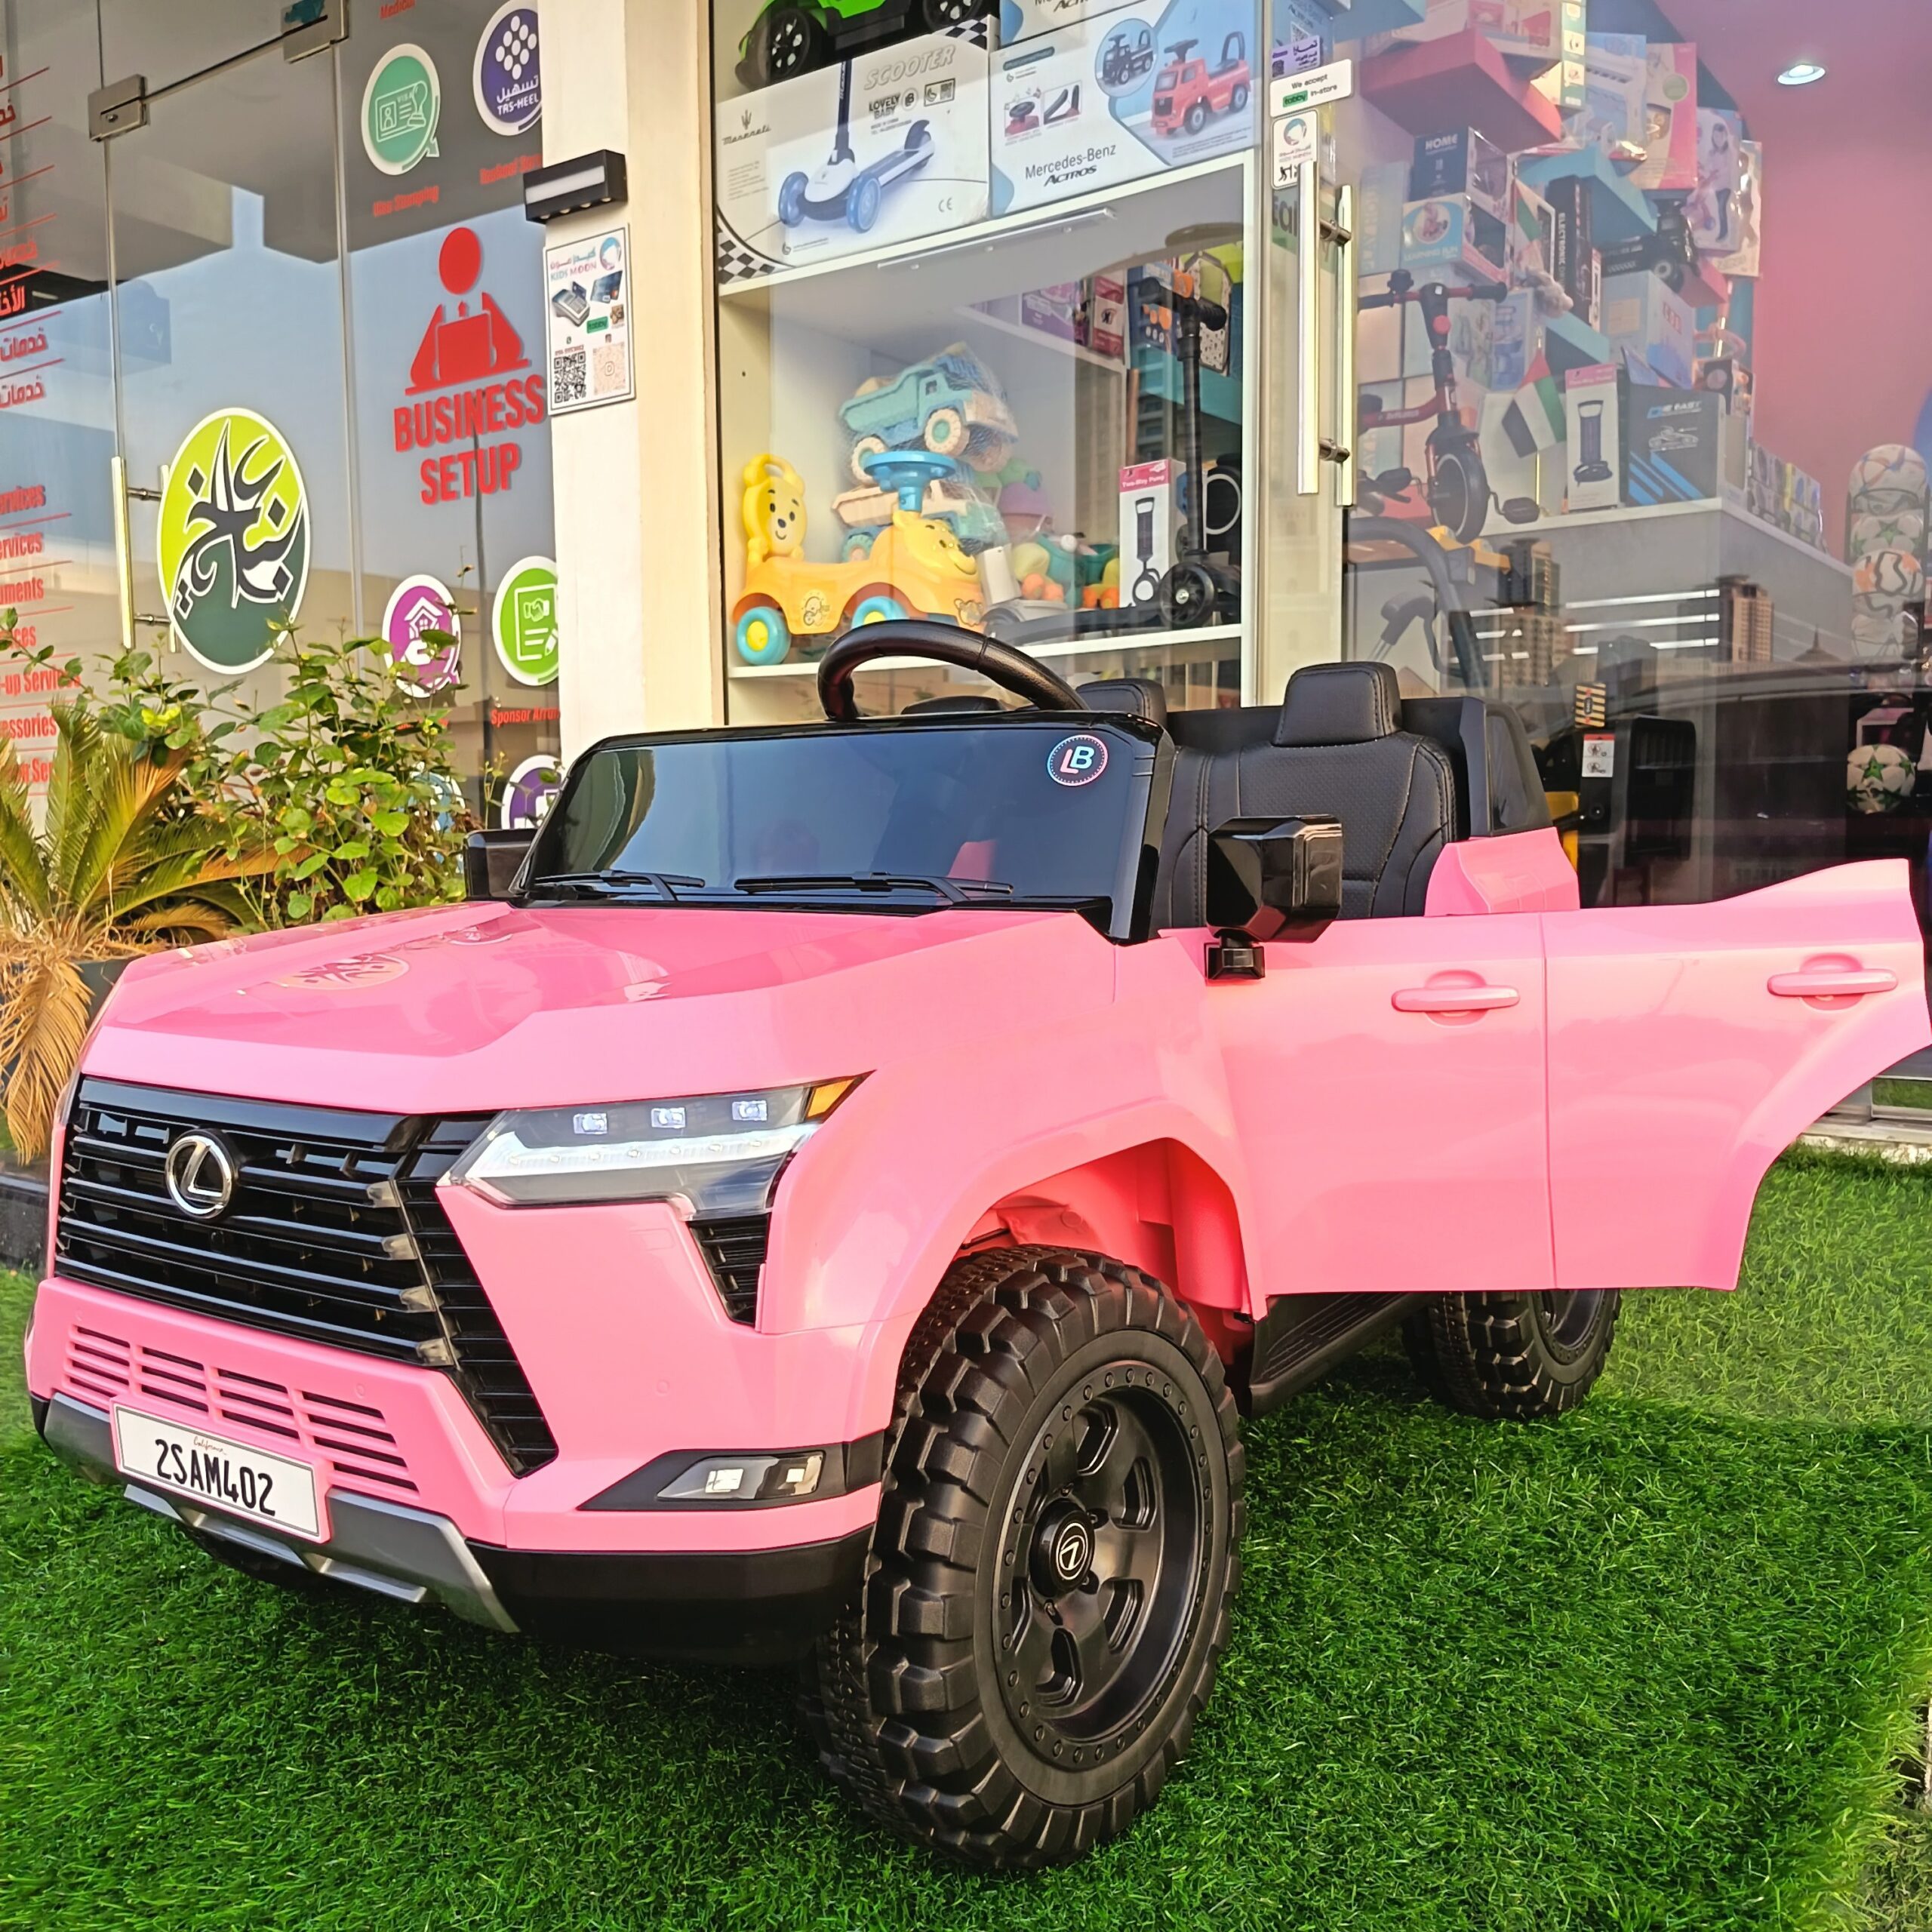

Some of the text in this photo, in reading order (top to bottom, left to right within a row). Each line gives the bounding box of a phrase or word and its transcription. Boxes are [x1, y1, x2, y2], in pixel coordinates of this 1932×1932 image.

[864, 45, 956, 91] SCOOTER
[1304, 74, 1328, 85] accept
[869, 93, 901, 112] LOVELY
[1425, 134, 1458, 150] HOME
[1026, 144, 1116, 180] Mercedes-Benz
[393, 374, 546, 453] BUSINESS
[420, 441, 521, 506] SETUP
[491, 708, 531, 729] Sponsor
[155, 1438, 275, 1517] 2SAM402
